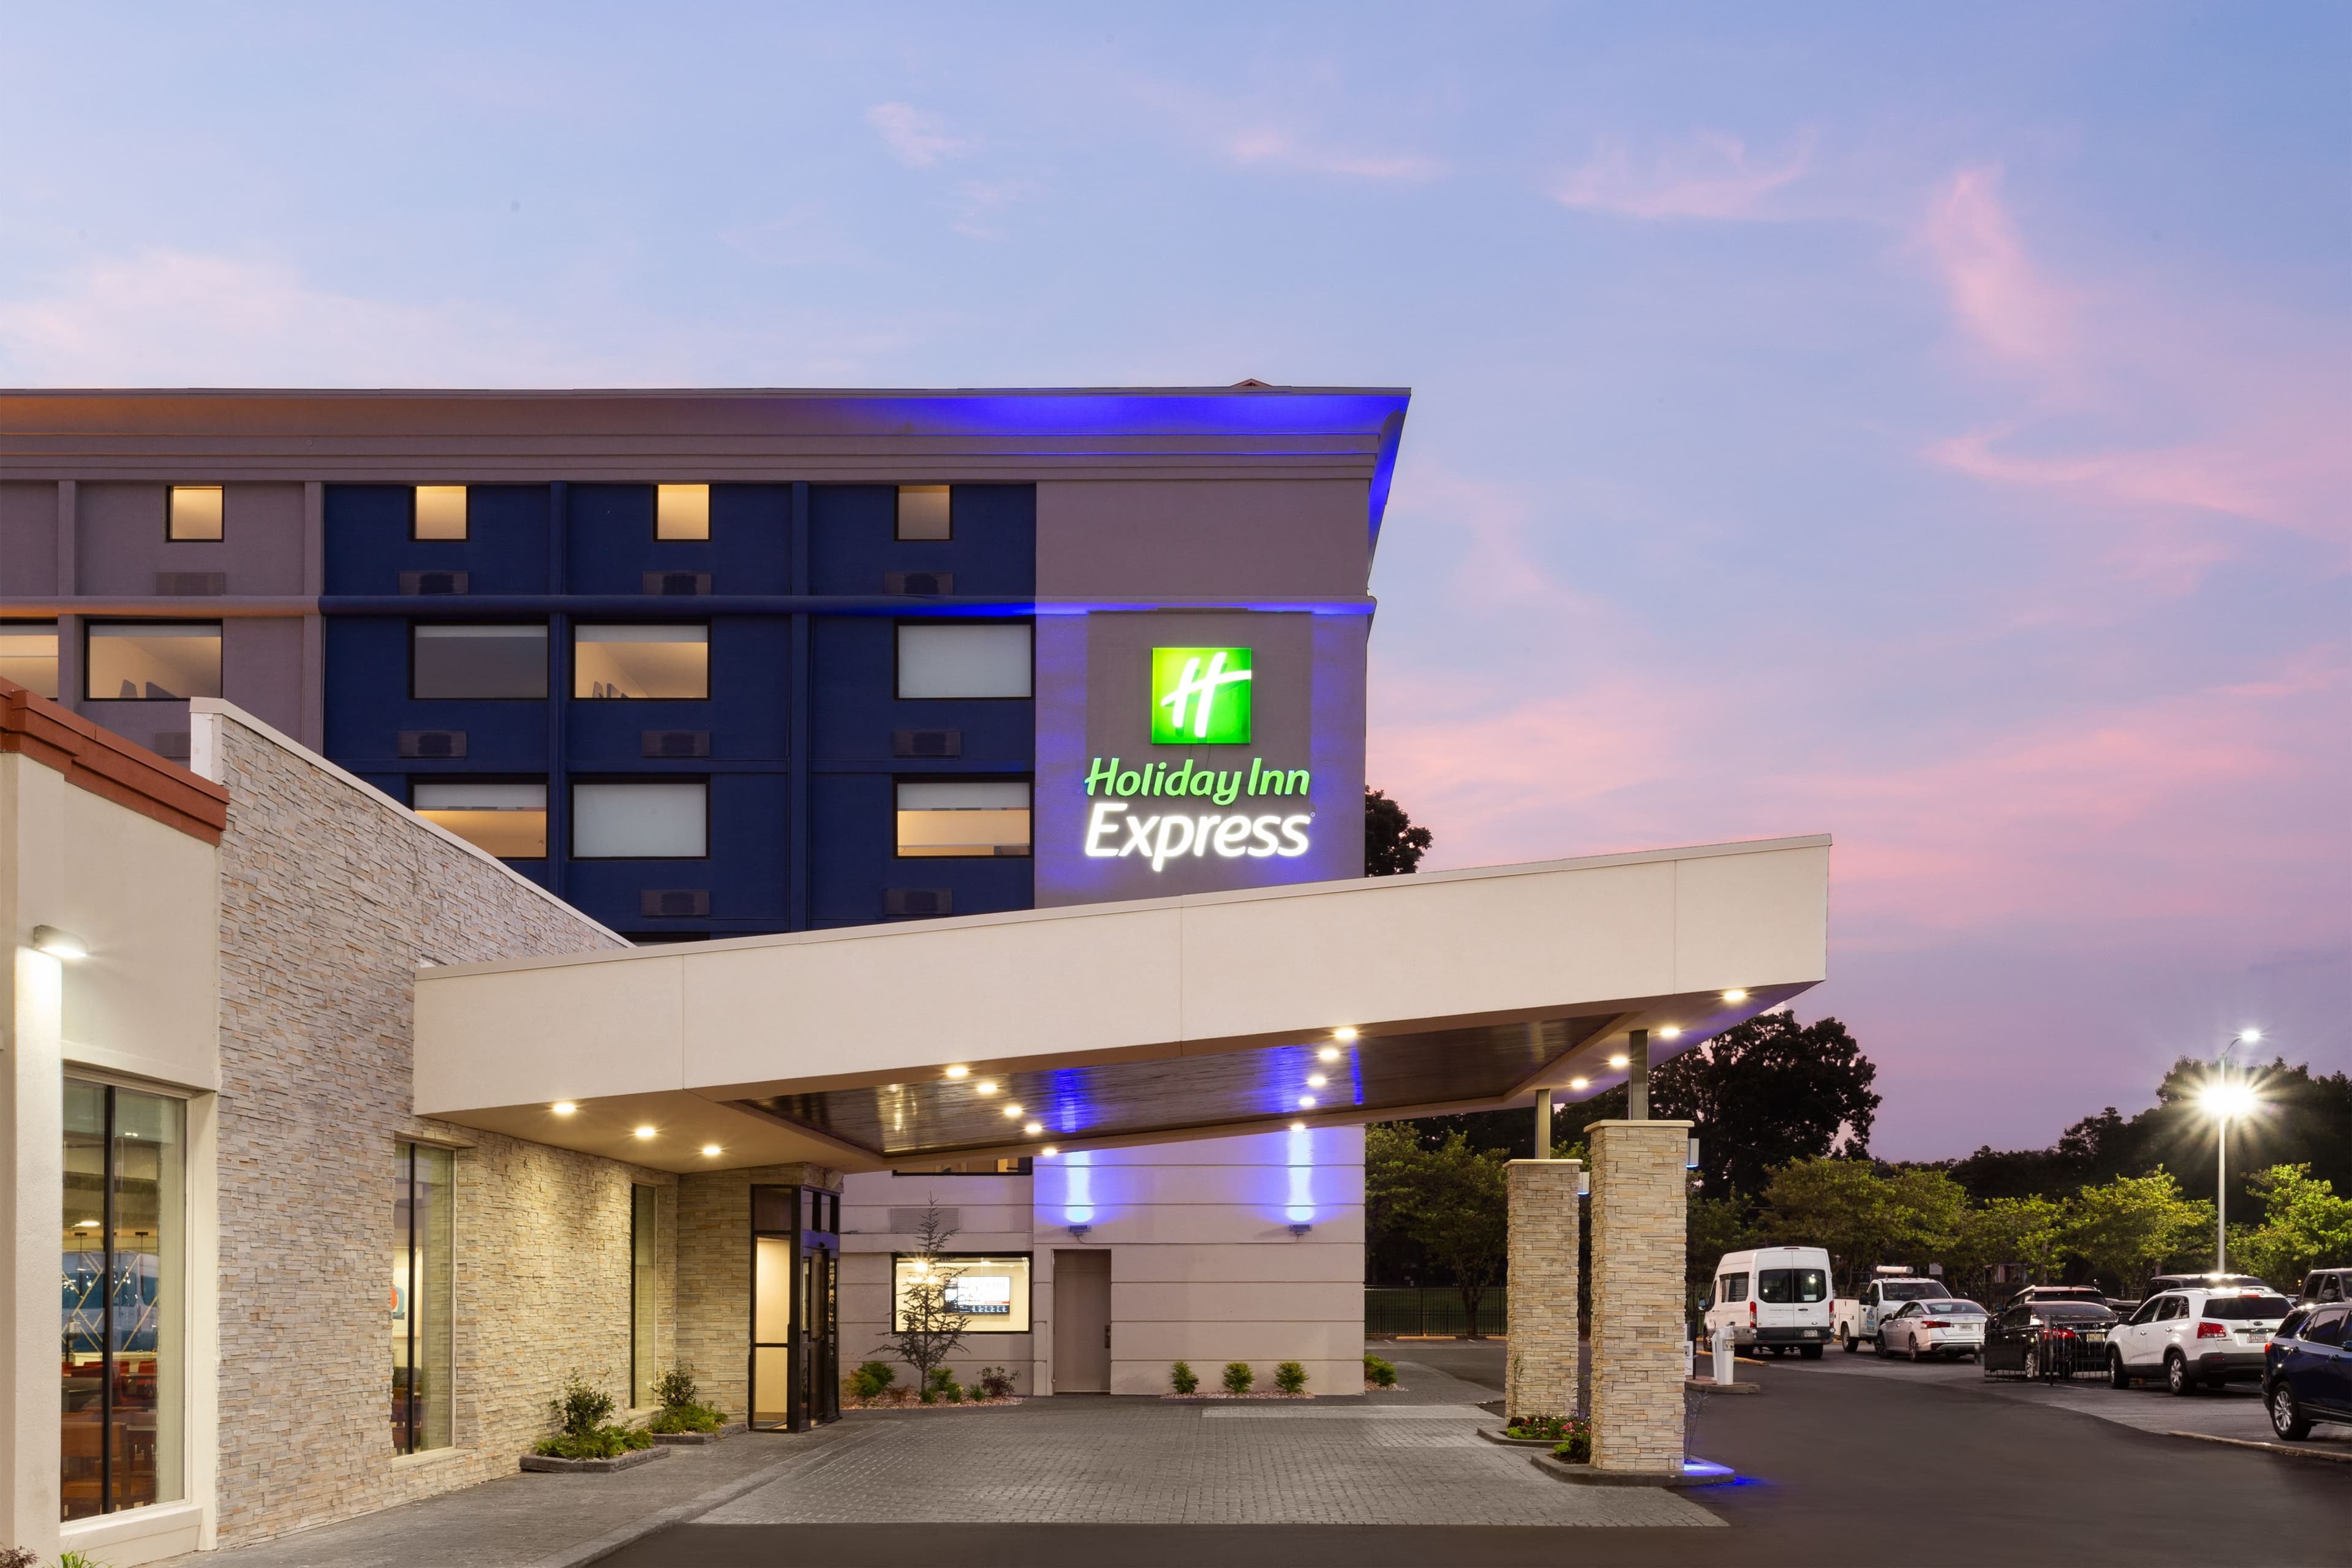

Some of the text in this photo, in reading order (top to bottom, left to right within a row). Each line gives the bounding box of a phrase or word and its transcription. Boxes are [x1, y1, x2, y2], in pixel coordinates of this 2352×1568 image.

[1085, 757, 1310, 806] Holiday Inn
[1084, 802, 1311, 872] Express
